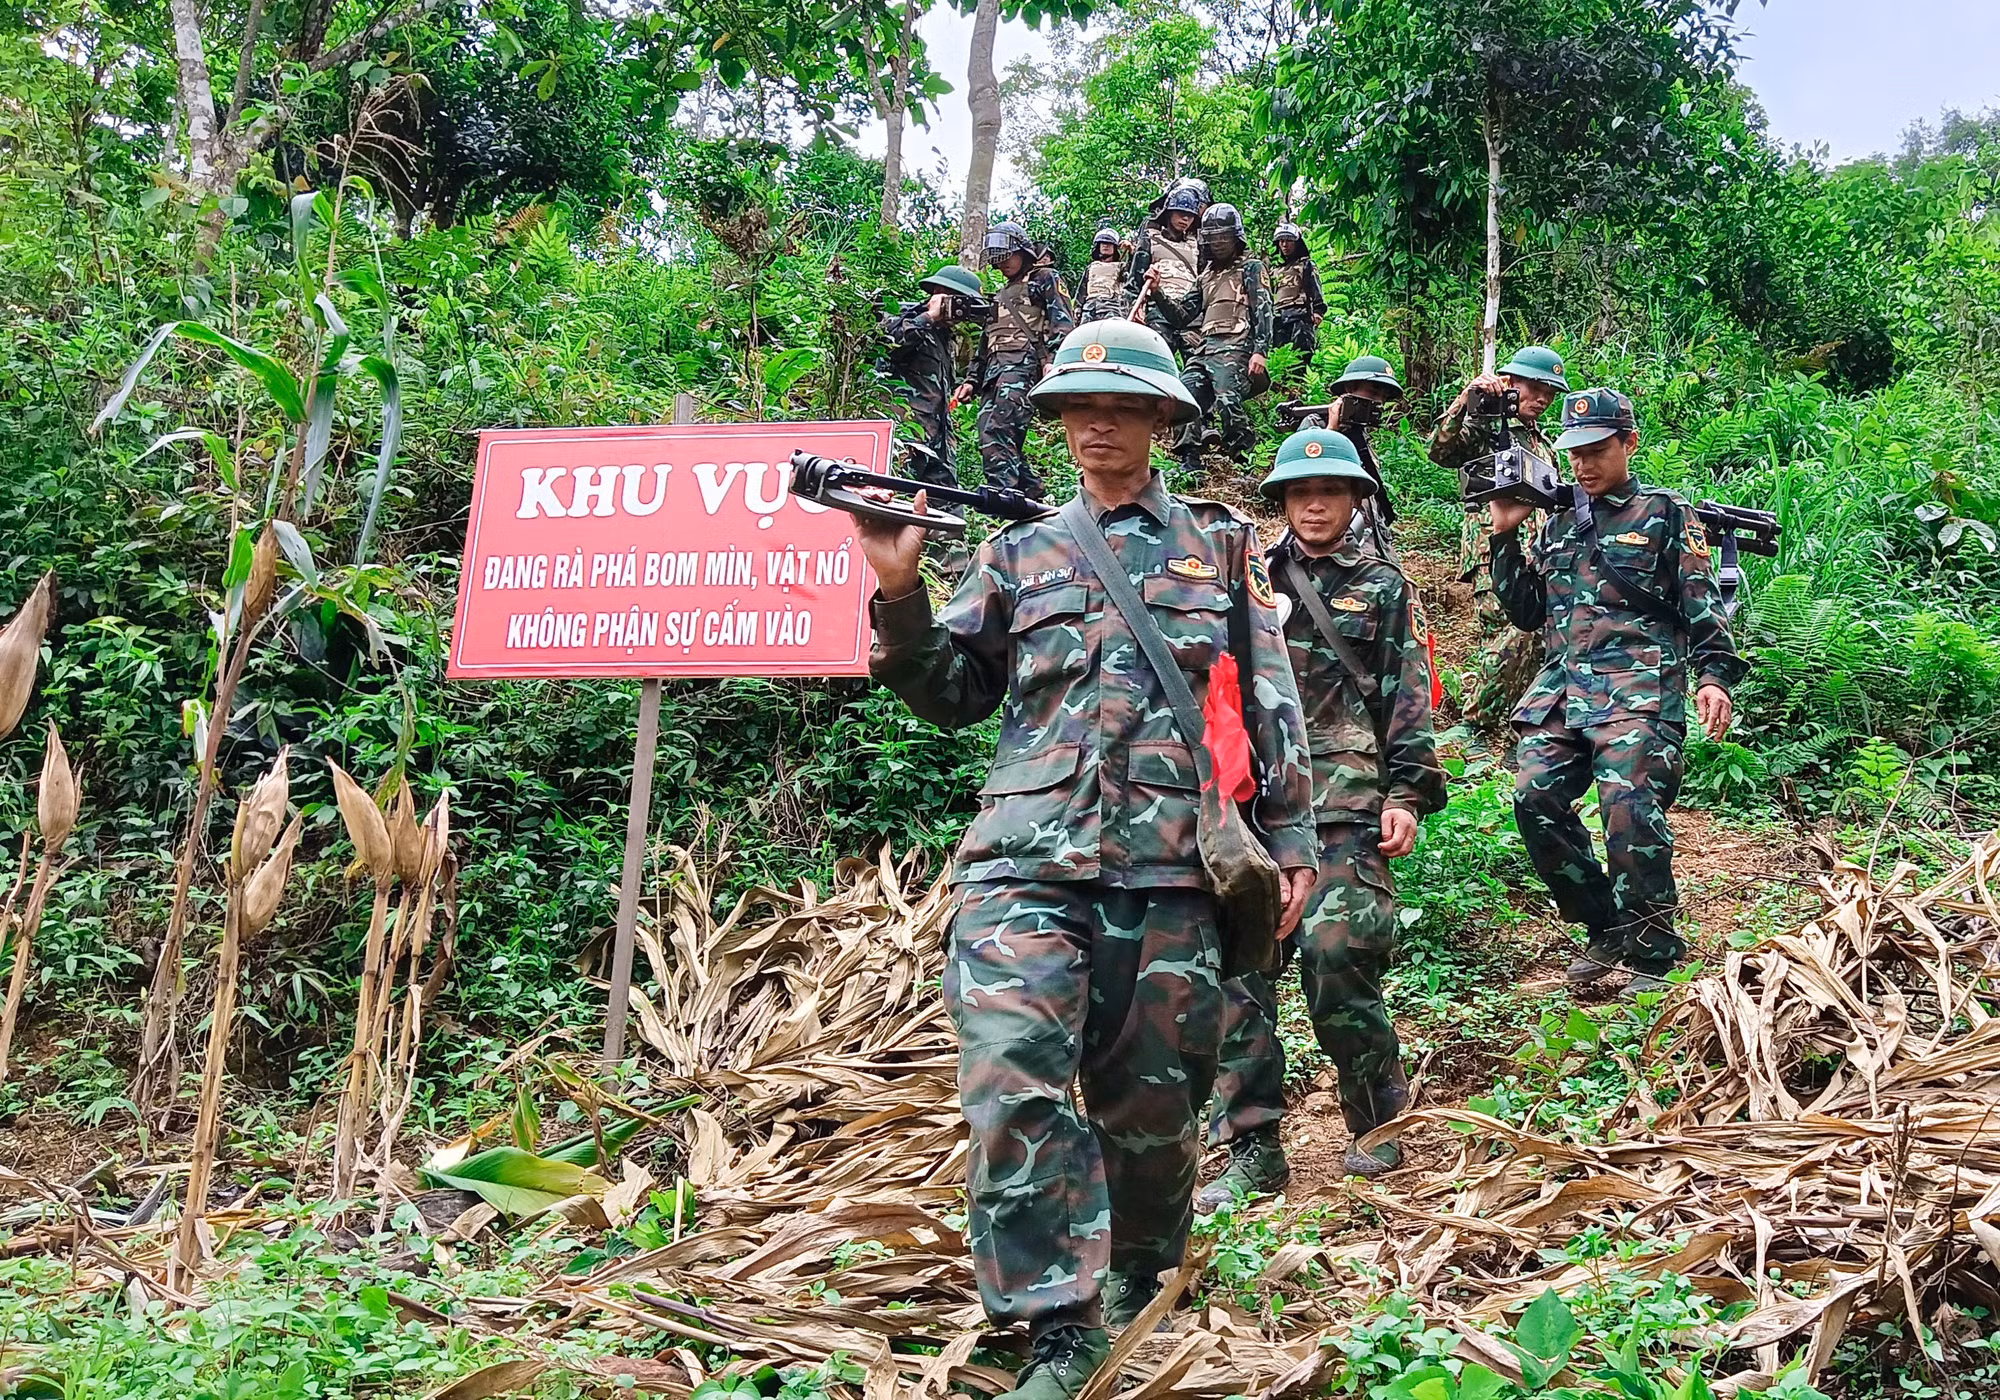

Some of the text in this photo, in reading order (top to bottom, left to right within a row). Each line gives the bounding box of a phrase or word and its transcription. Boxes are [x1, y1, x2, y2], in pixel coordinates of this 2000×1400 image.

[515, 463, 673, 519] KHU
[483, 536, 853, 593] ĐANG RÀ PHÁ BOM MÌN, VẬT NỔ
[506, 598, 812, 655] KHÔNG PHẬN SỰ CẤM VÀO
